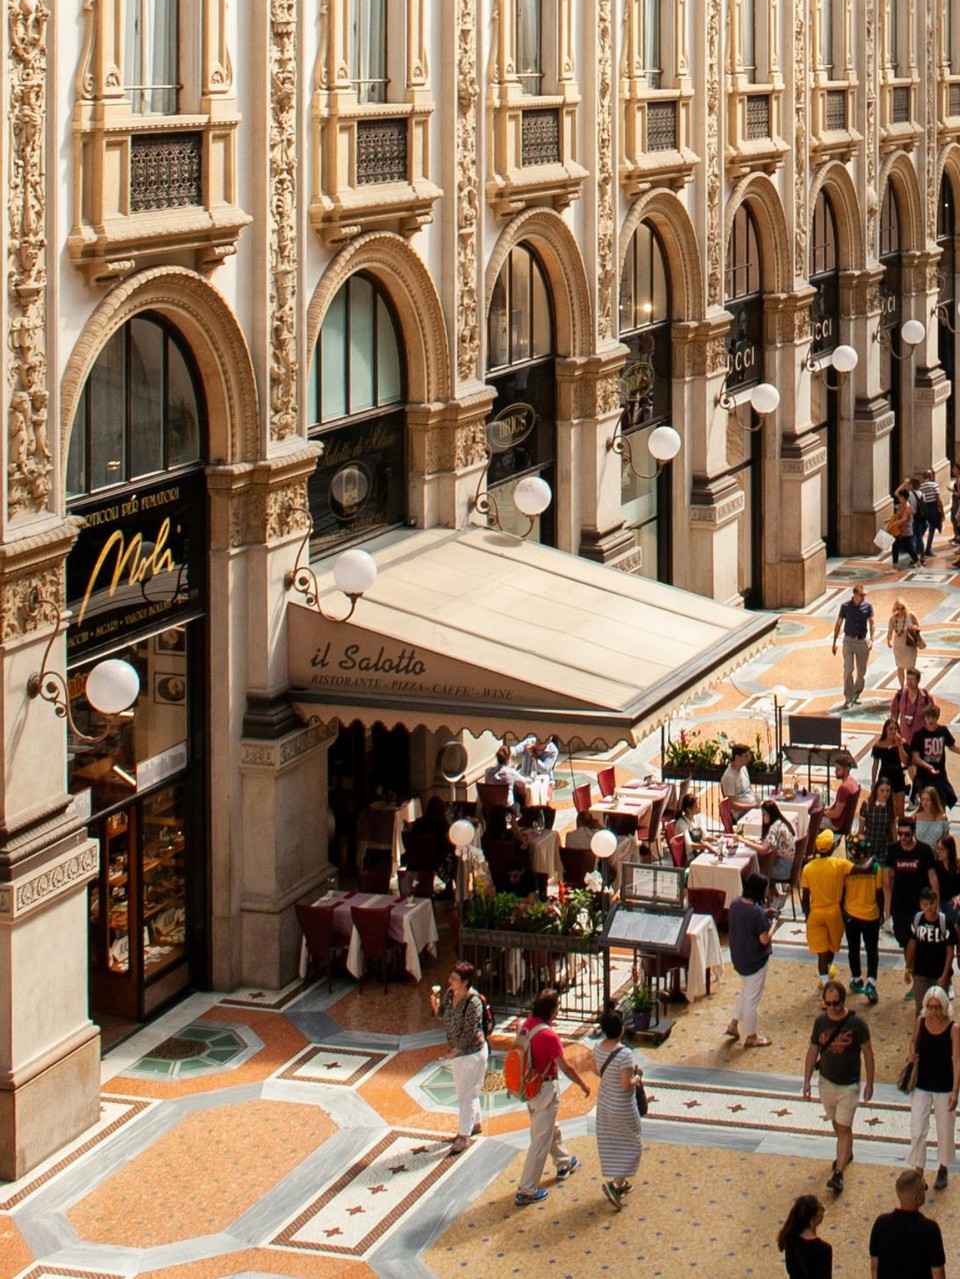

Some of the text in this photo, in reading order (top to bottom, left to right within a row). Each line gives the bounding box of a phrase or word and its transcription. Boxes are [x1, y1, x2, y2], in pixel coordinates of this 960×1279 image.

[141, 487, 180, 511] FUMATORI
[310, 642, 426, 676] il Salotto
[311, 673, 381, 689] RISTORANTE
[391, 679, 424, 692] PIZZA
[482, 687, 514, 700] WINE
[924, 736, 945, 756] 501
